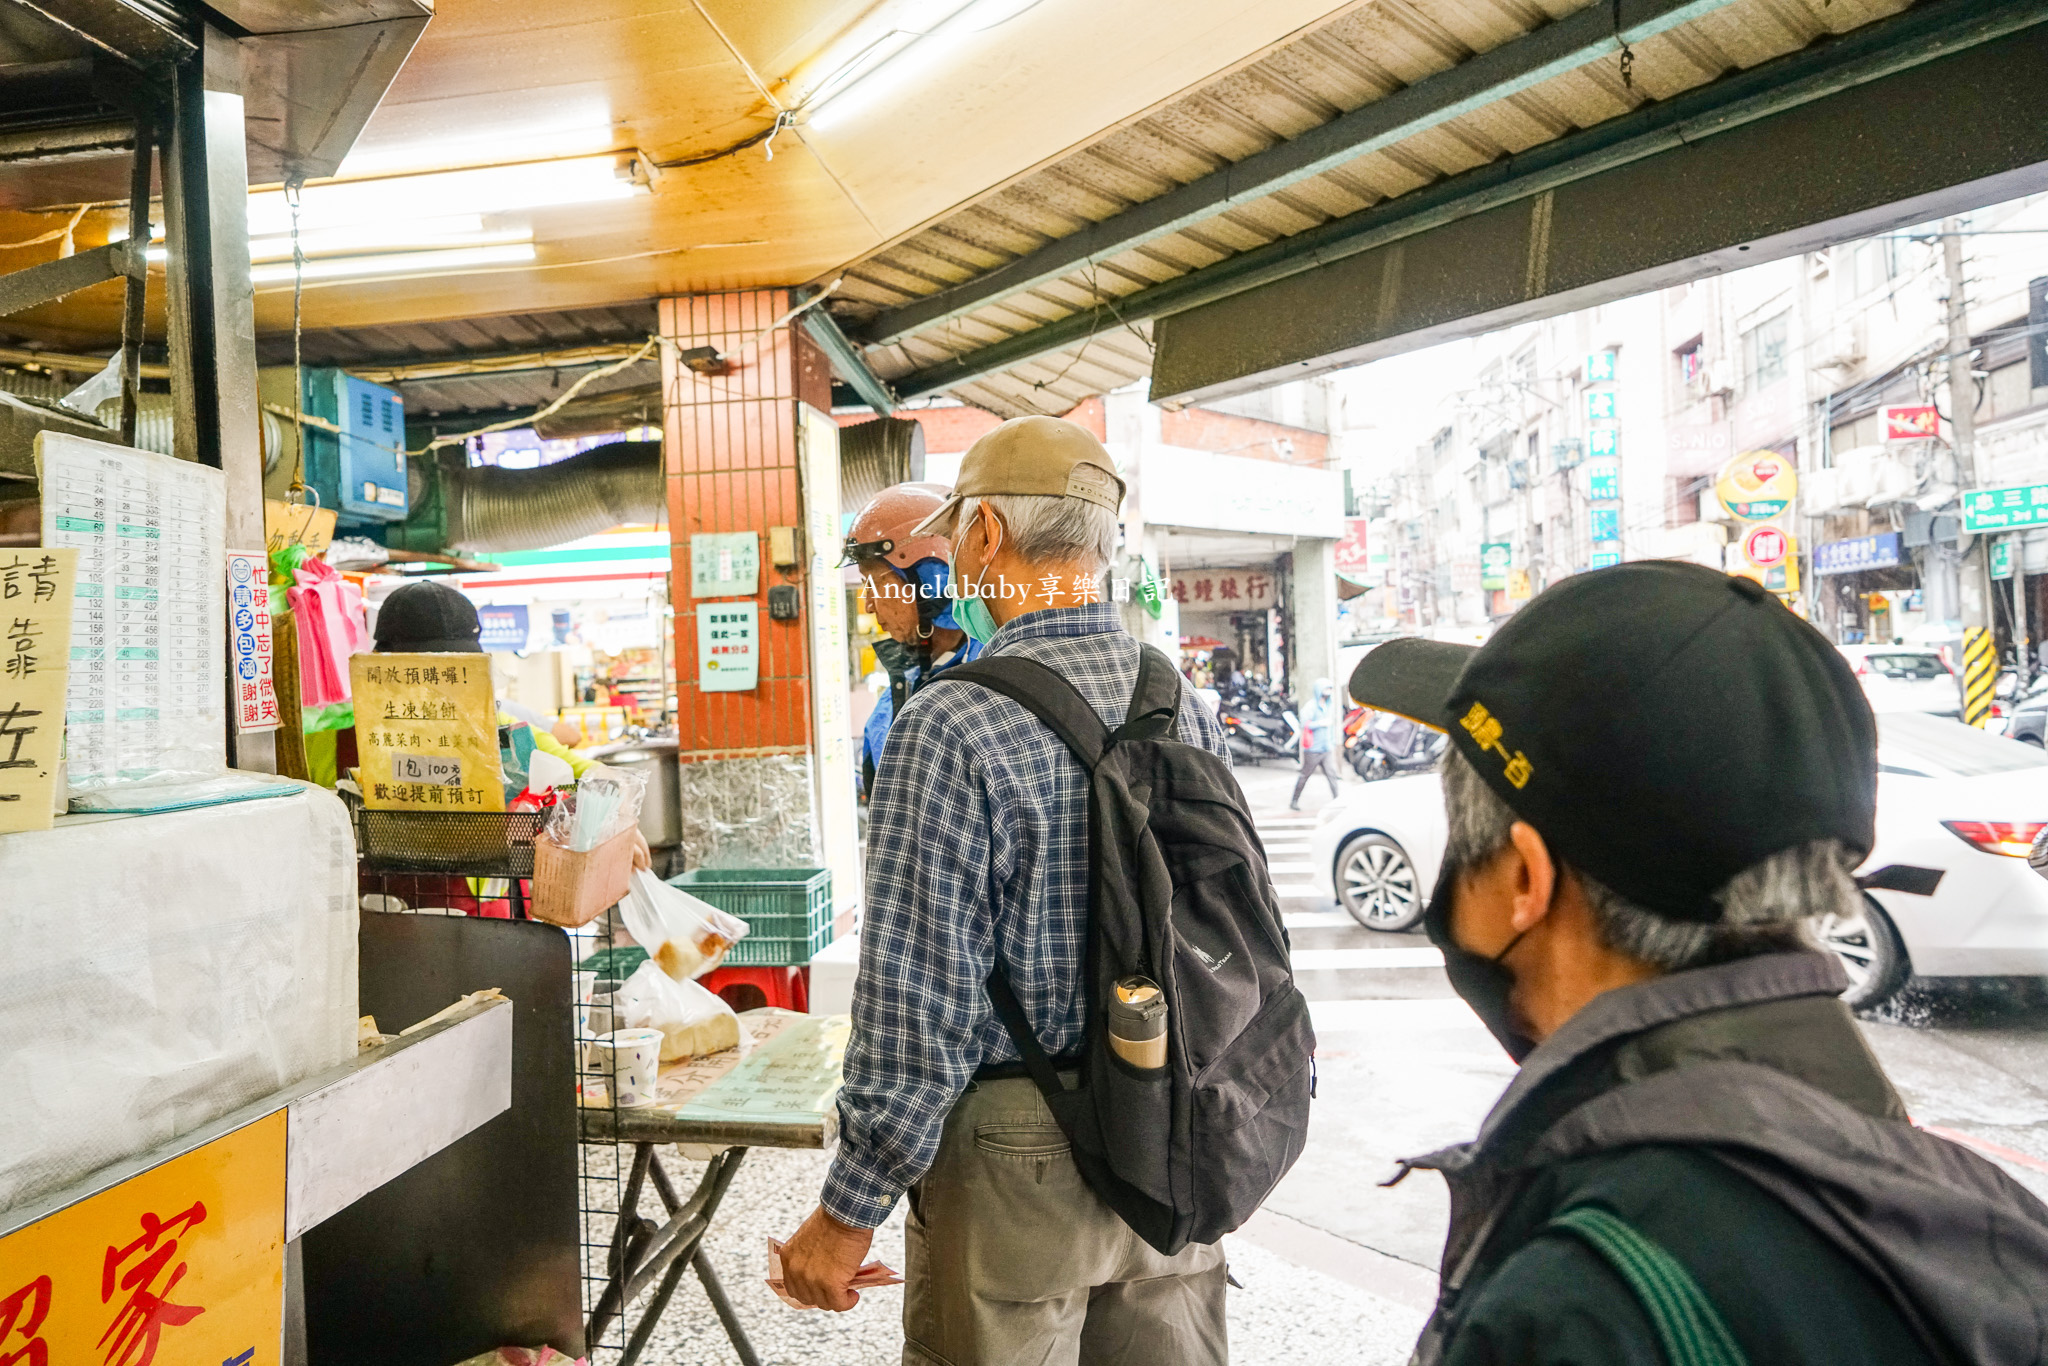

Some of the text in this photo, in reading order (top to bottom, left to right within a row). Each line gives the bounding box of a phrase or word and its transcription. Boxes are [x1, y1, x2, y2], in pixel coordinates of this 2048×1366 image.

[233, 585, 259, 722] 請多包涵謝謝
[252, 565, 277, 720] 忙碌中忘了微笑
[711, 629, 749, 640] 僅此一家
[374, 784, 485, 805] 歡迎提前預訂
